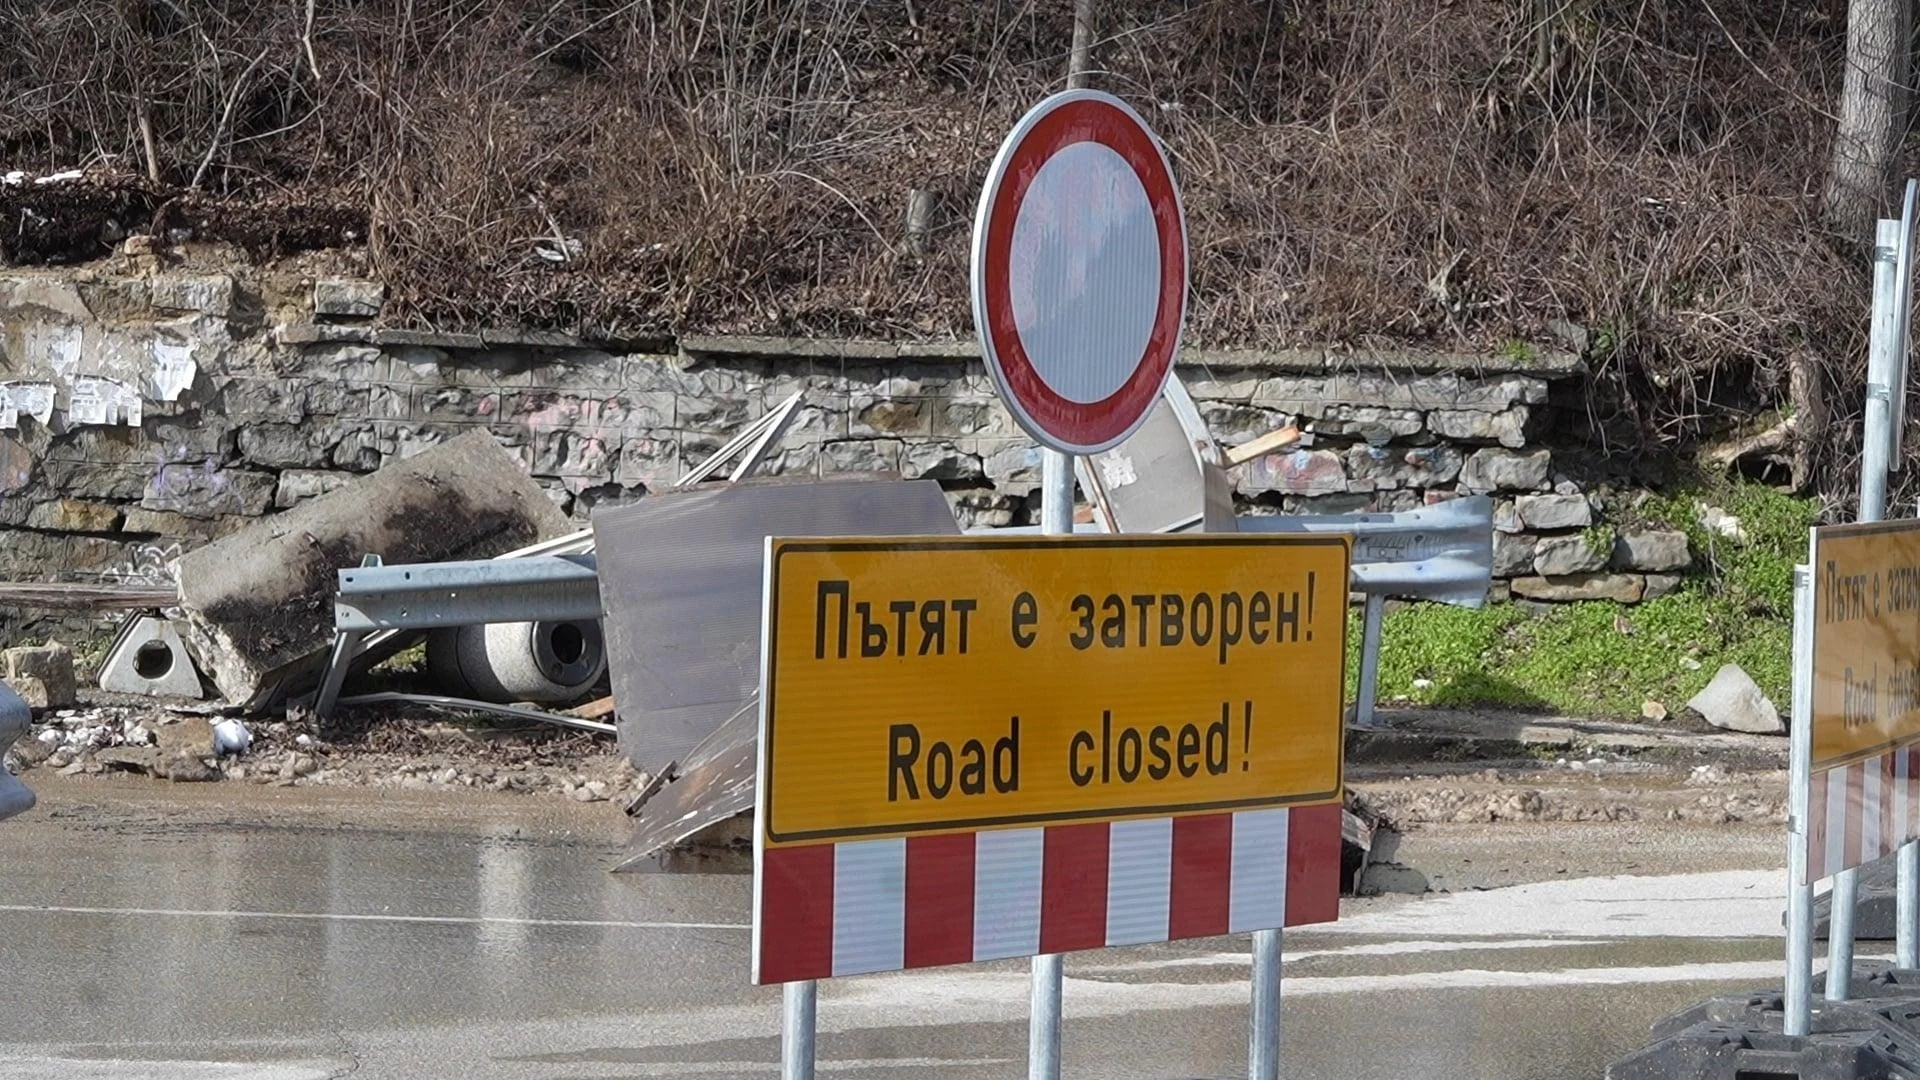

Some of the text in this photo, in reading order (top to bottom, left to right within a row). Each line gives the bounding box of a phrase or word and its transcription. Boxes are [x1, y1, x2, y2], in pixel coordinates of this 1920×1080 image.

[815, 572, 1317, 664] Пътят е затворен!
[1825, 561, 1867, 624] Пътят
[1873, 572, 1881, 618] е
[1843, 662, 1877, 729] Road
[888, 701, 1253, 802] Road closed!
